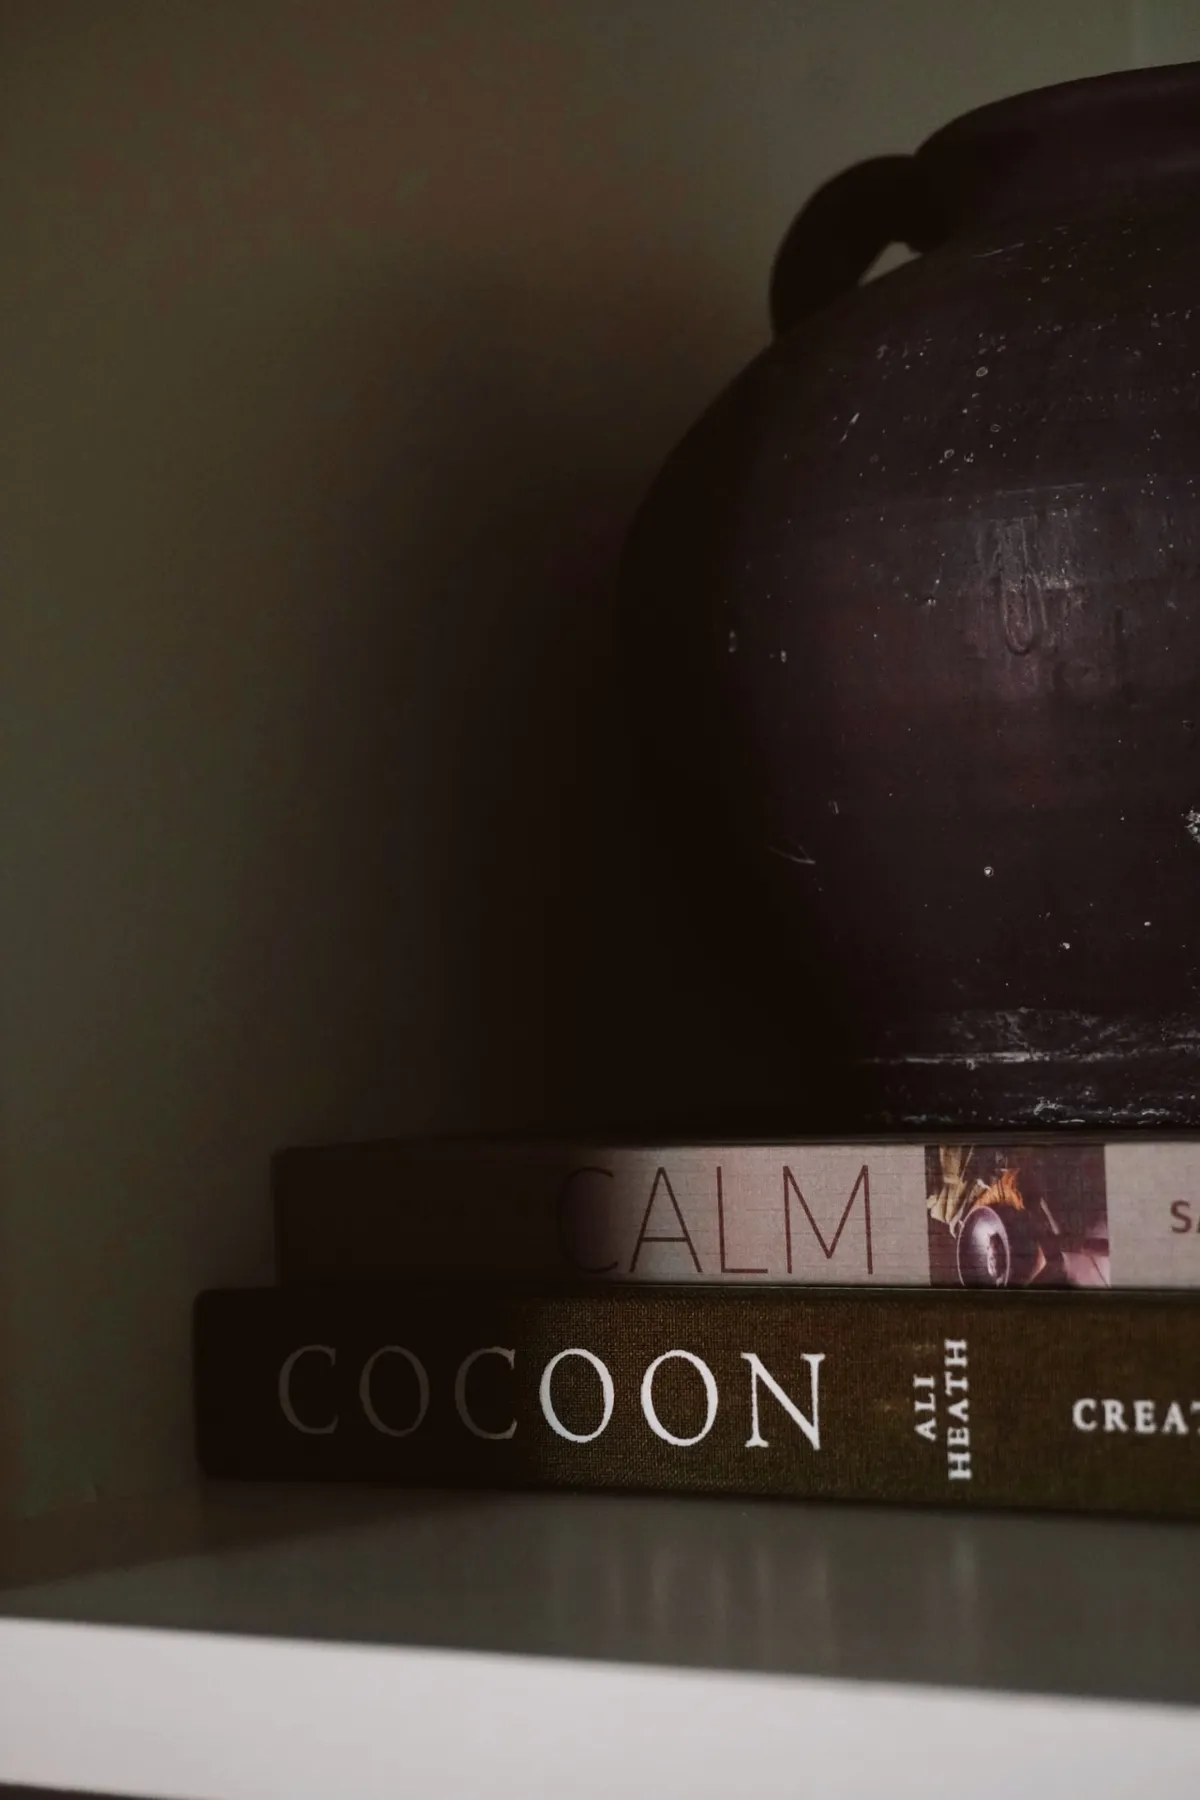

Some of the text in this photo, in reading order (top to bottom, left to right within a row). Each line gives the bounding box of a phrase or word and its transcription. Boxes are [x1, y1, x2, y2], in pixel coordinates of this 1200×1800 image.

[556, 1164, 873, 1276] CALM
[1169, 1199, 1200, 1234] S
[277, 1343, 826, 1451] COCOON
[913, 1374, 937, 1442] ALI
[943, 1338, 973, 1481] HEATH
